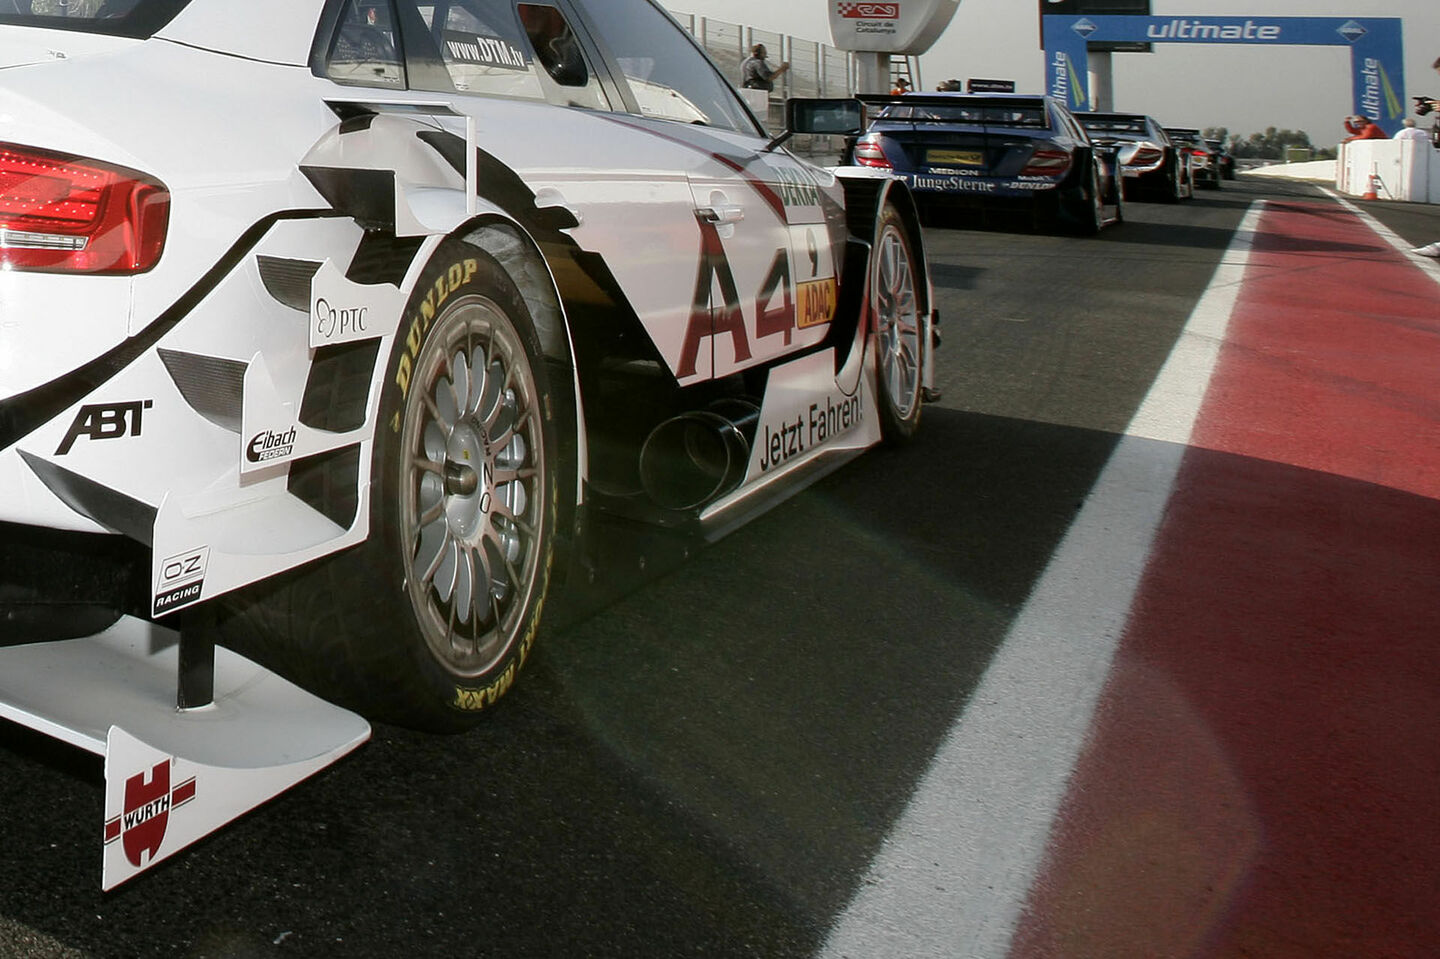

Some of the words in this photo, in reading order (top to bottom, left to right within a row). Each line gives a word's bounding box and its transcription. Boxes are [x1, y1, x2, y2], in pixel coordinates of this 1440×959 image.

[1147, 20, 1281, 40] ultimate
[447, 37, 525, 68] www.DTM.tv
[1362, 58, 1379, 121] ultimate
[912, 175, 995, 191] JungeSterne
[928, 168, 979, 176] MEDION
[1010, 182, 1056, 190] DUNLOP
[676, 212, 796, 379] A4
[804, 282, 831, 324] ADAC
[339, 307, 368, 335] PTC
[396, 258, 478, 400] DUNLOP
[54, 400, 153, 456] ABT
[246, 425, 296, 463] Eibach
[760, 414, 804, 471] Jetzt
[259, 445, 293, 461] FEDERN
[156, 585, 200, 607] RACING
[453, 662, 516, 710] MAXX
